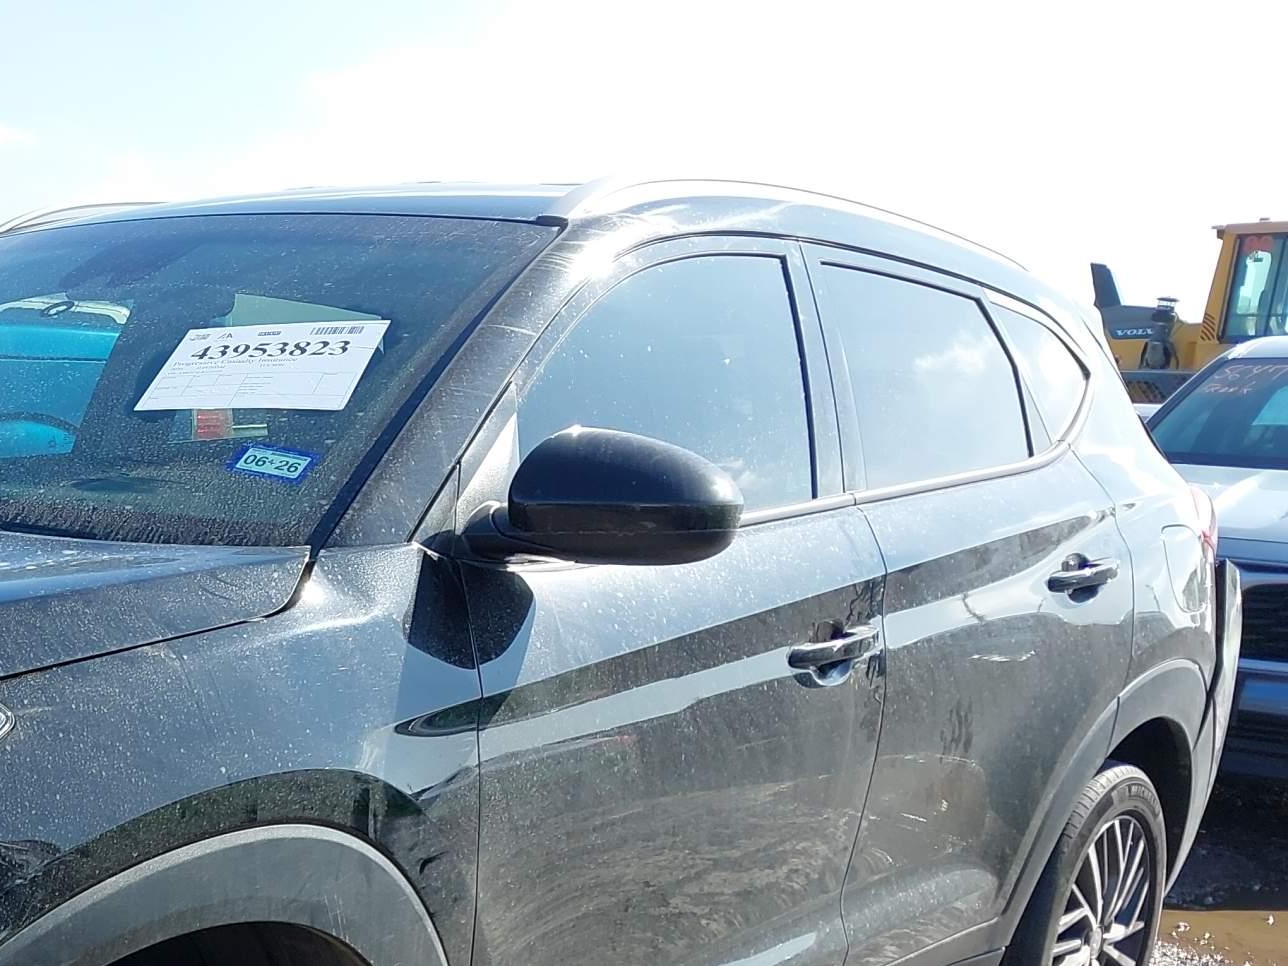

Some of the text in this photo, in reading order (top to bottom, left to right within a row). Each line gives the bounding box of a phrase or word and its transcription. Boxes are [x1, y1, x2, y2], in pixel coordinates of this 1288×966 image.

[1115, 327, 1154, 336] VOLV
[190, 340, 352, 360] 43953823
[243, 454, 269, 467] 06
[273, 459, 302, 473] 26
